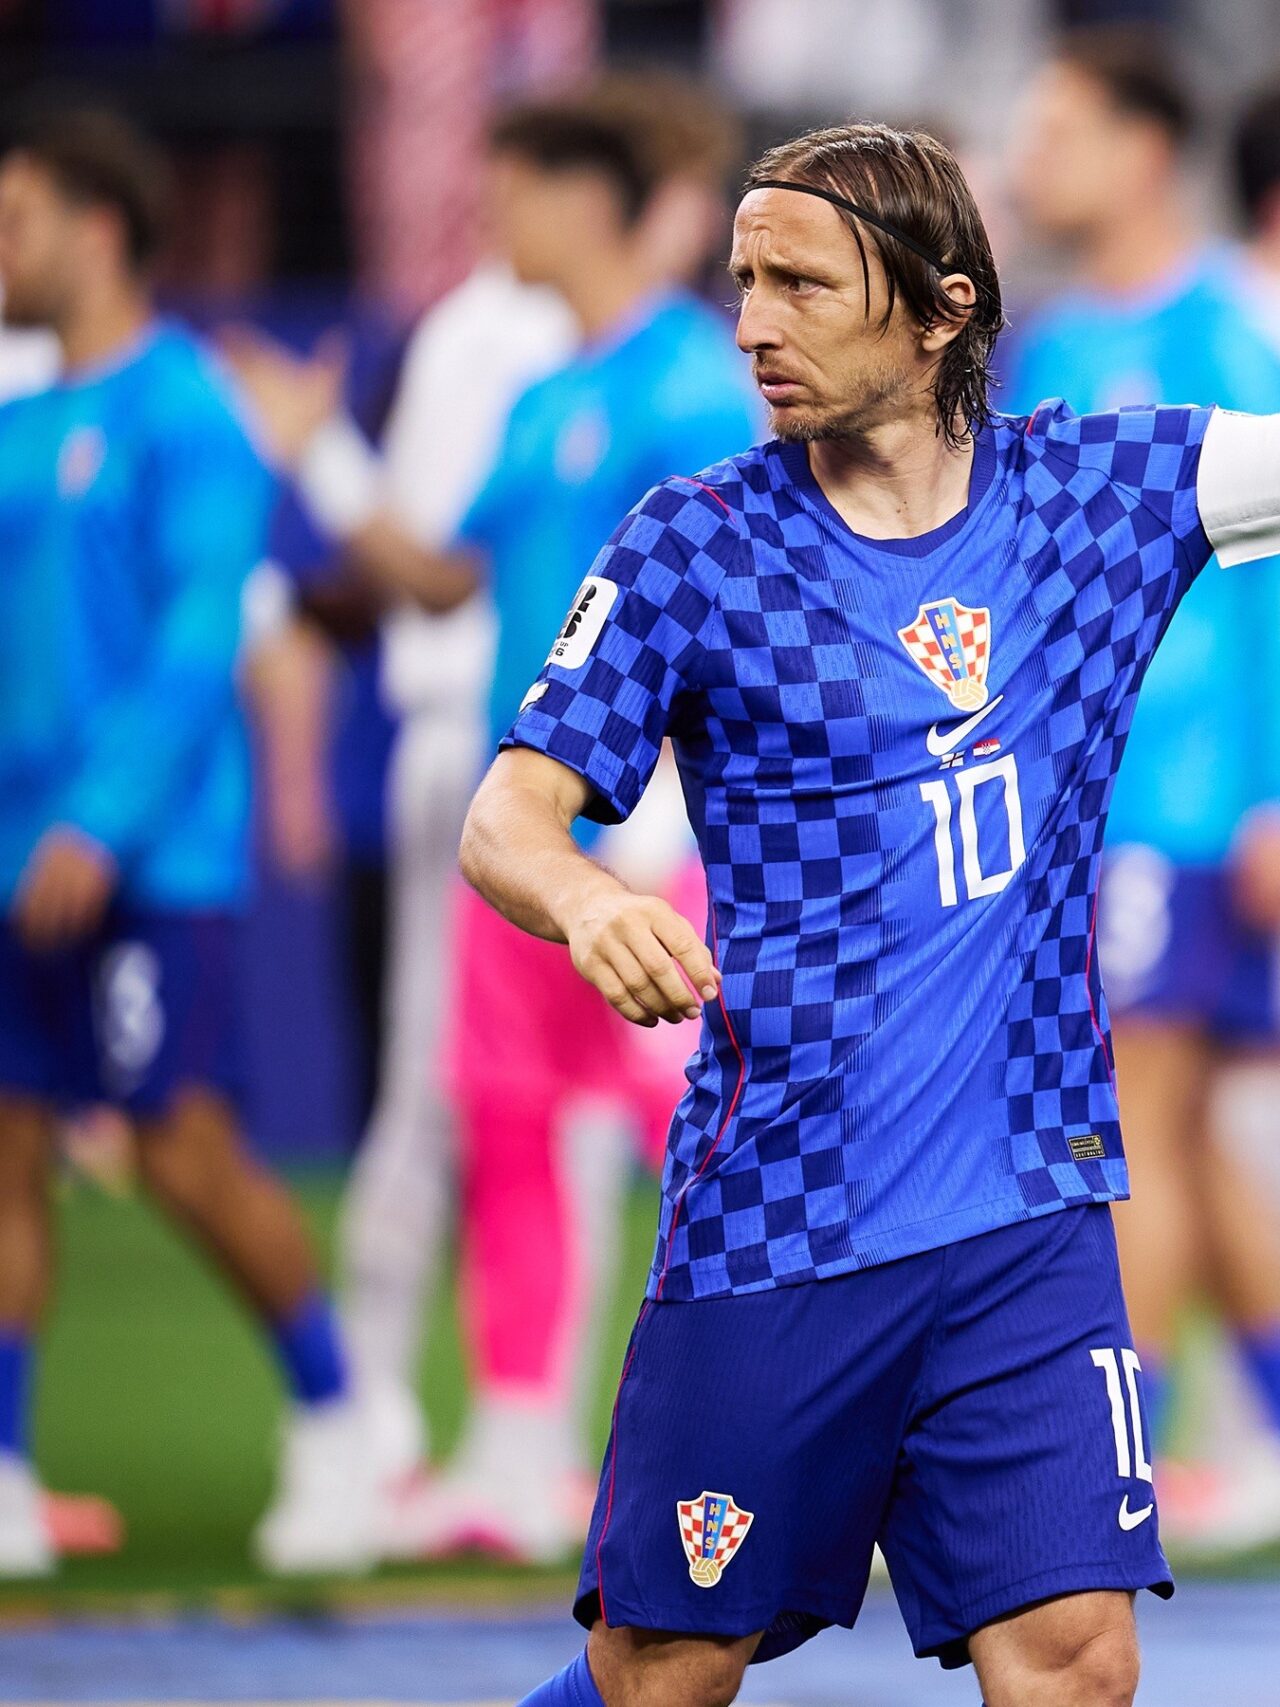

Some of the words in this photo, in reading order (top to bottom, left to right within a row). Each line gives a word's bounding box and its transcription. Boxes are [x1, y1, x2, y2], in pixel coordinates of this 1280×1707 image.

[934, 613, 963, 670] HNS
[919, 753, 1026, 907] 10
[1089, 1348, 1153, 1483] 10
[704, 1503, 722, 1550] HNS
